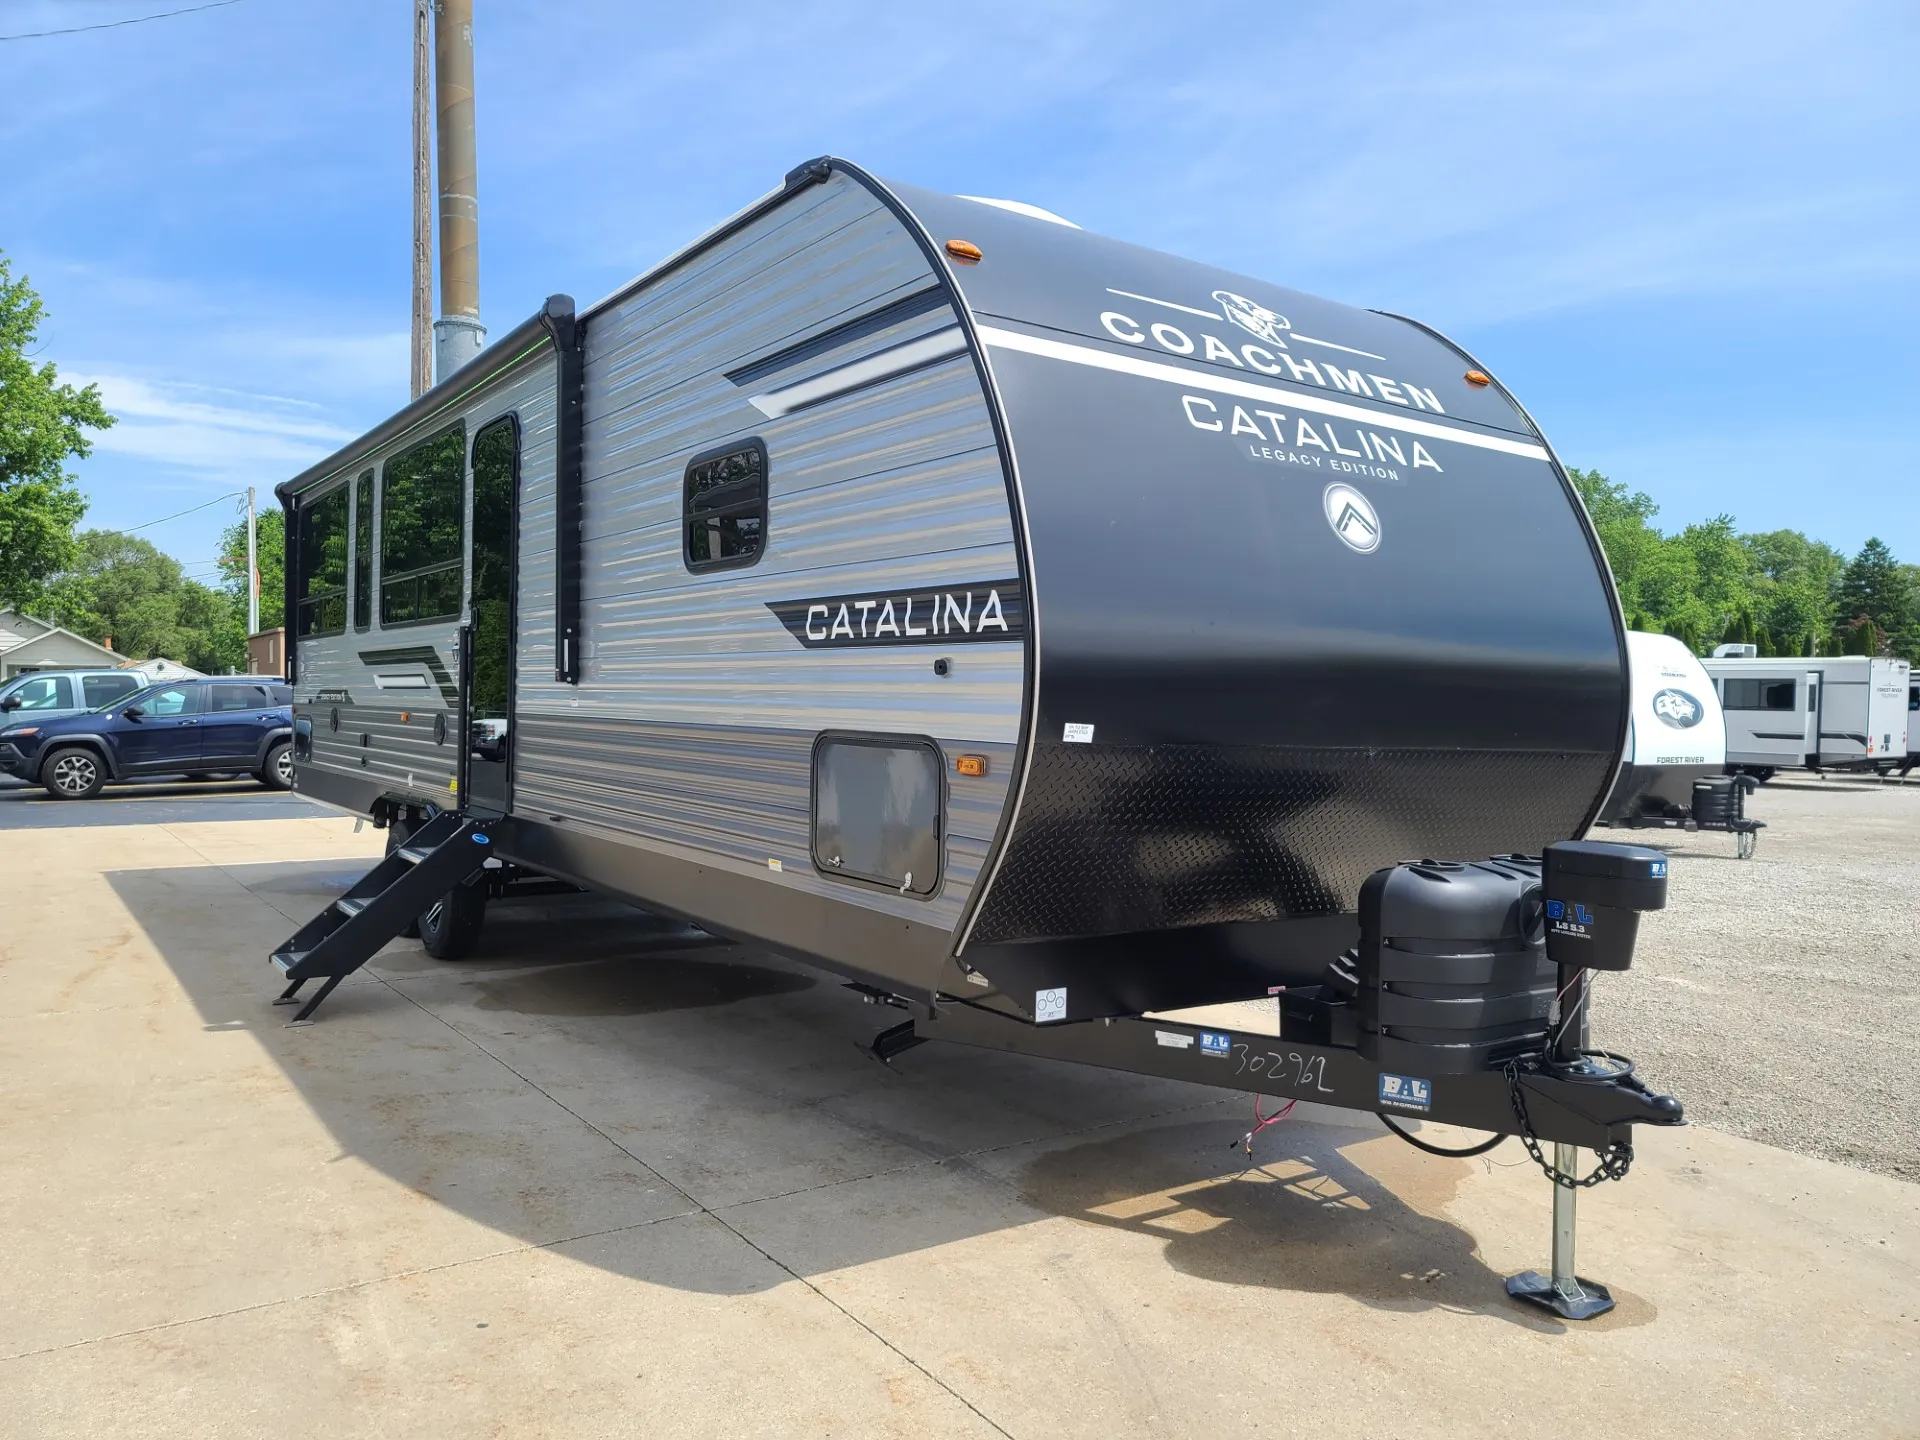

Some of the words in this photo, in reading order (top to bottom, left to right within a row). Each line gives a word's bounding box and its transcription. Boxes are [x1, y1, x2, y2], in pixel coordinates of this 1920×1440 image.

[1099, 310, 1446, 414] COACHMEN
[1181, 394, 1444, 473] CATALINA
[1250, 444, 1322, 468] LEGACY
[1330, 458, 1399, 481] EDITION
[804, 589, 1009, 641] CATALINA
[1656, 756, 1683, 764] FOREST
[1684, 756, 1704, 764] RIVER
[1555, 920, 1568, 930] LS
